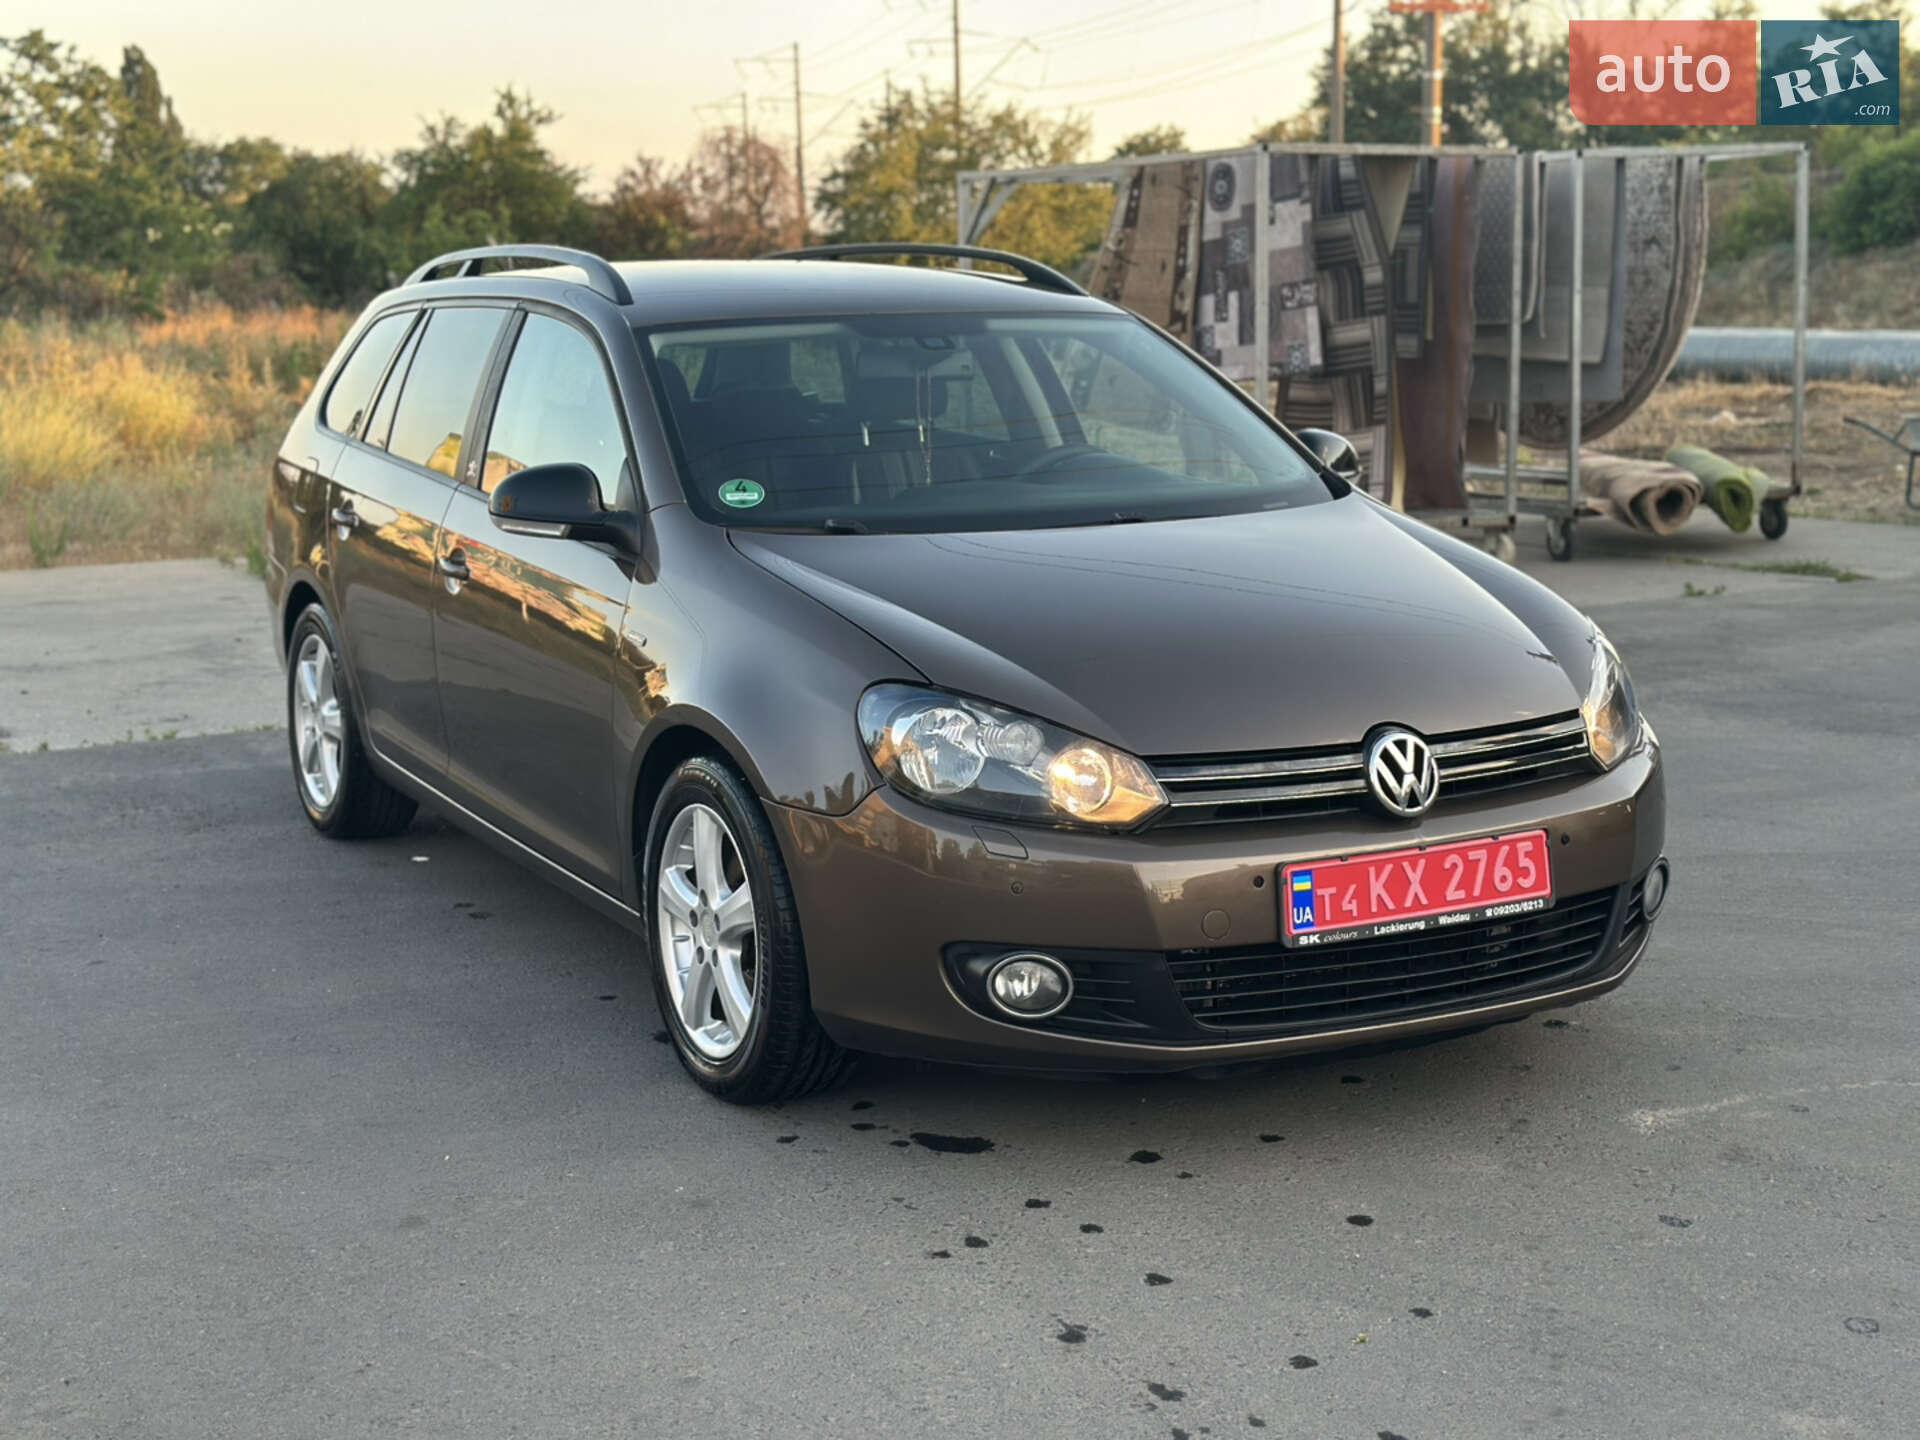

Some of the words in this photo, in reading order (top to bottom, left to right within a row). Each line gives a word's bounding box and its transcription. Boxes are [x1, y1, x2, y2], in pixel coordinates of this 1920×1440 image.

[735, 480, 747, 493] 4
[1443, 841, 1537, 901] 2765
[1293, 906, 1314, 924] UA
[1299, 934, 1321, 945] SK
[1373, 920, 1426, 936] Lackierung
